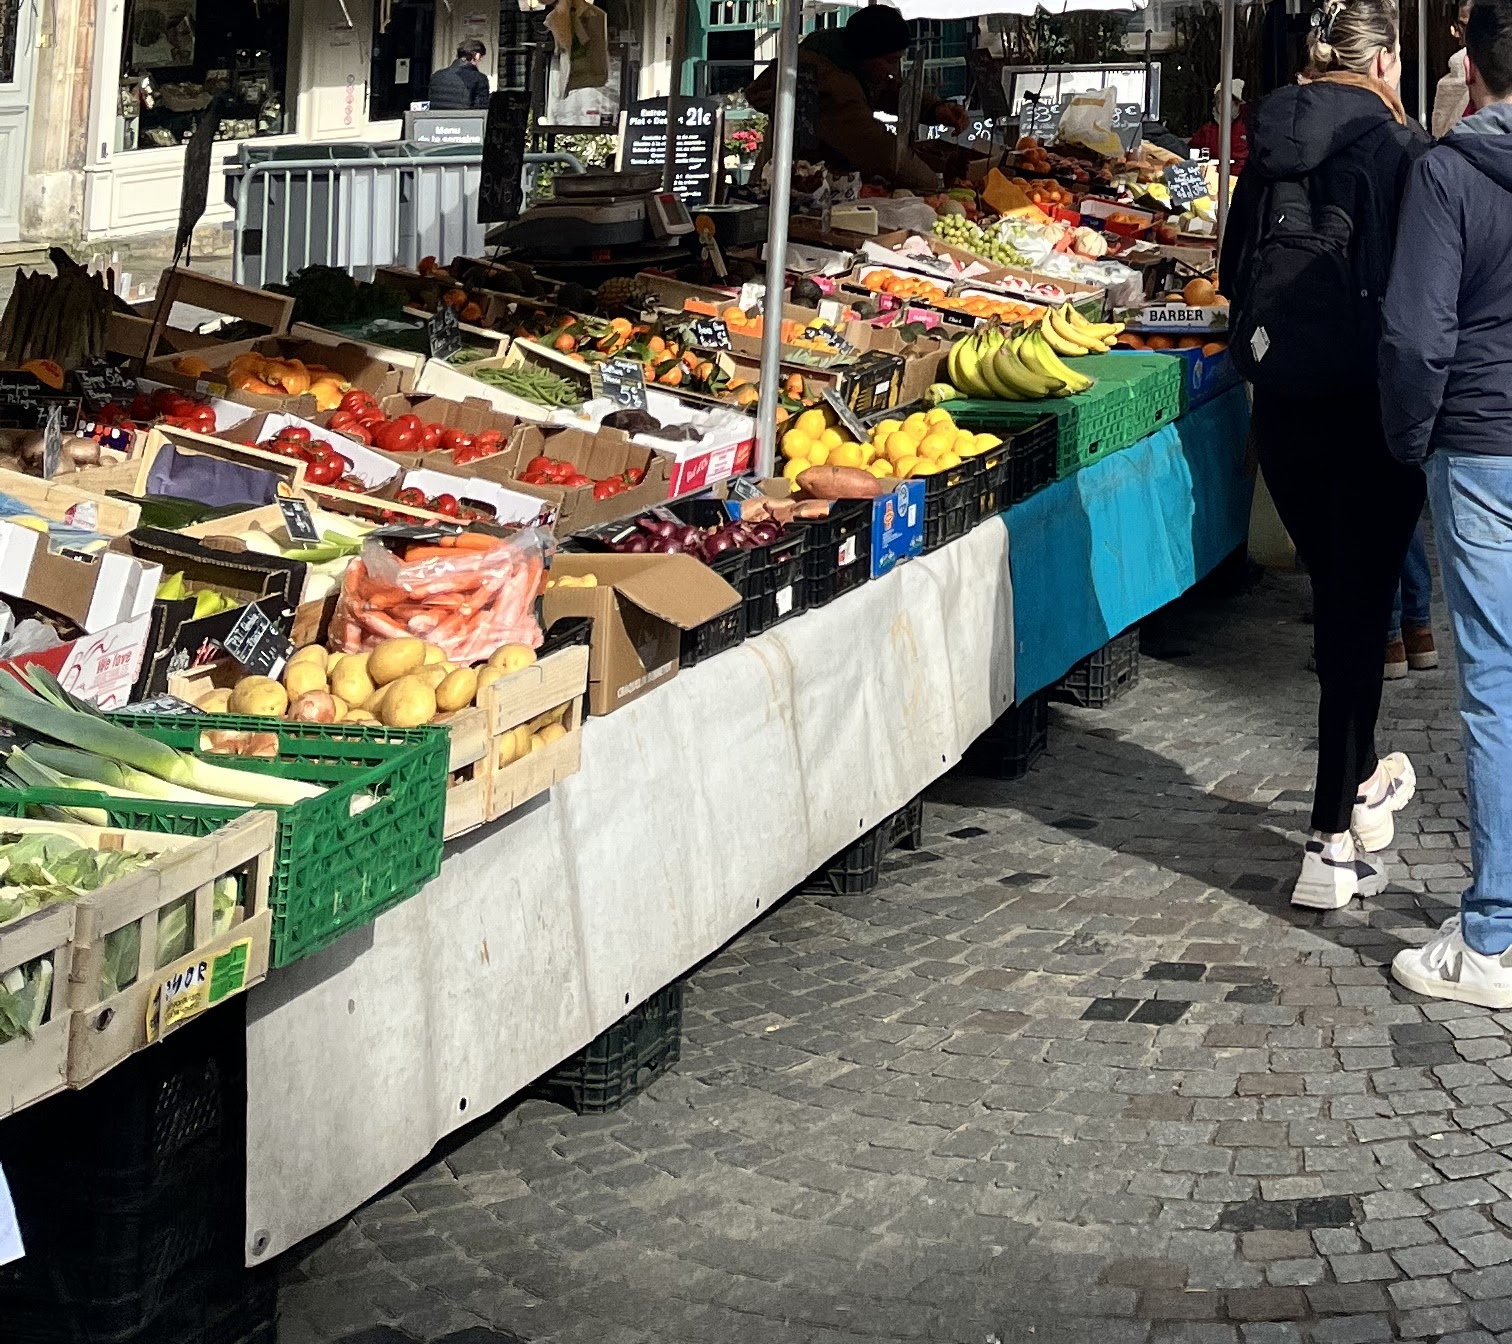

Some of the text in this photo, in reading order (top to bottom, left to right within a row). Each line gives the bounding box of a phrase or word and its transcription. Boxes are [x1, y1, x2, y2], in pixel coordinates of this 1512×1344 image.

[1149, 309, 1204, 322] BARBER
[97, 650, 132, 674] We love
